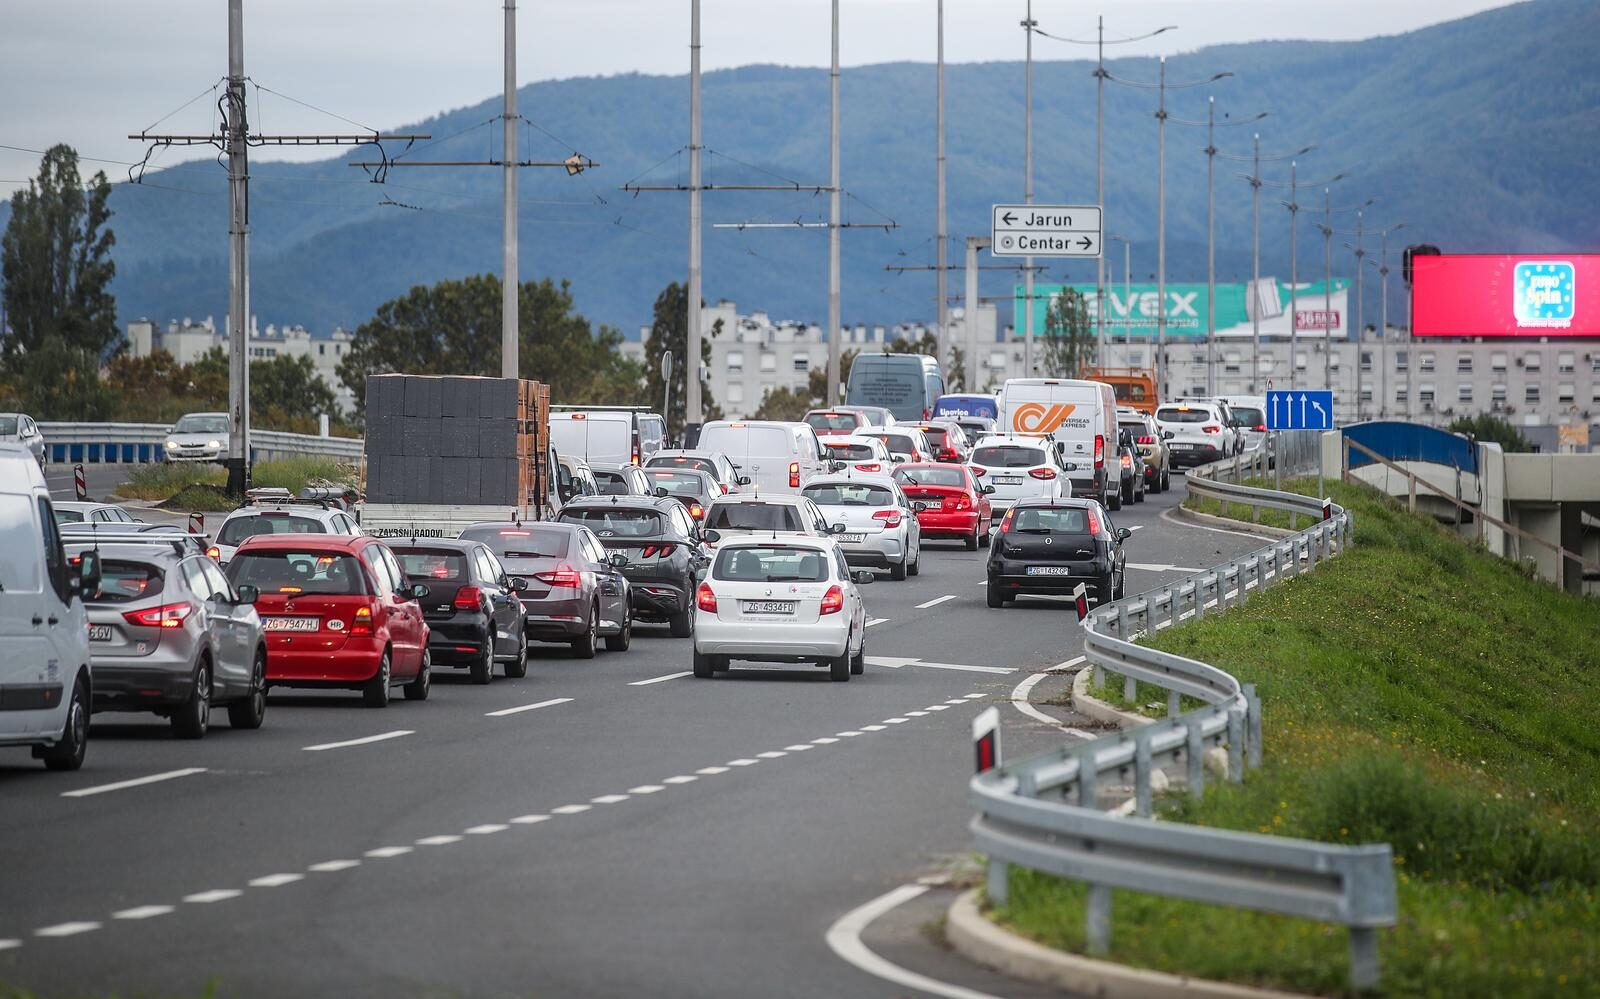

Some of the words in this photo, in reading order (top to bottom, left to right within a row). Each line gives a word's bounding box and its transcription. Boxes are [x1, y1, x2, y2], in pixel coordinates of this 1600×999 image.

[1025, 212, 1072, 226] Jarun
[1018, 235, 1072, 249] Centar
[414, 528, 443, 538] RADOVI
[748, 602, 759, 611] ZG
[267, 619, 278, 628] ZG
